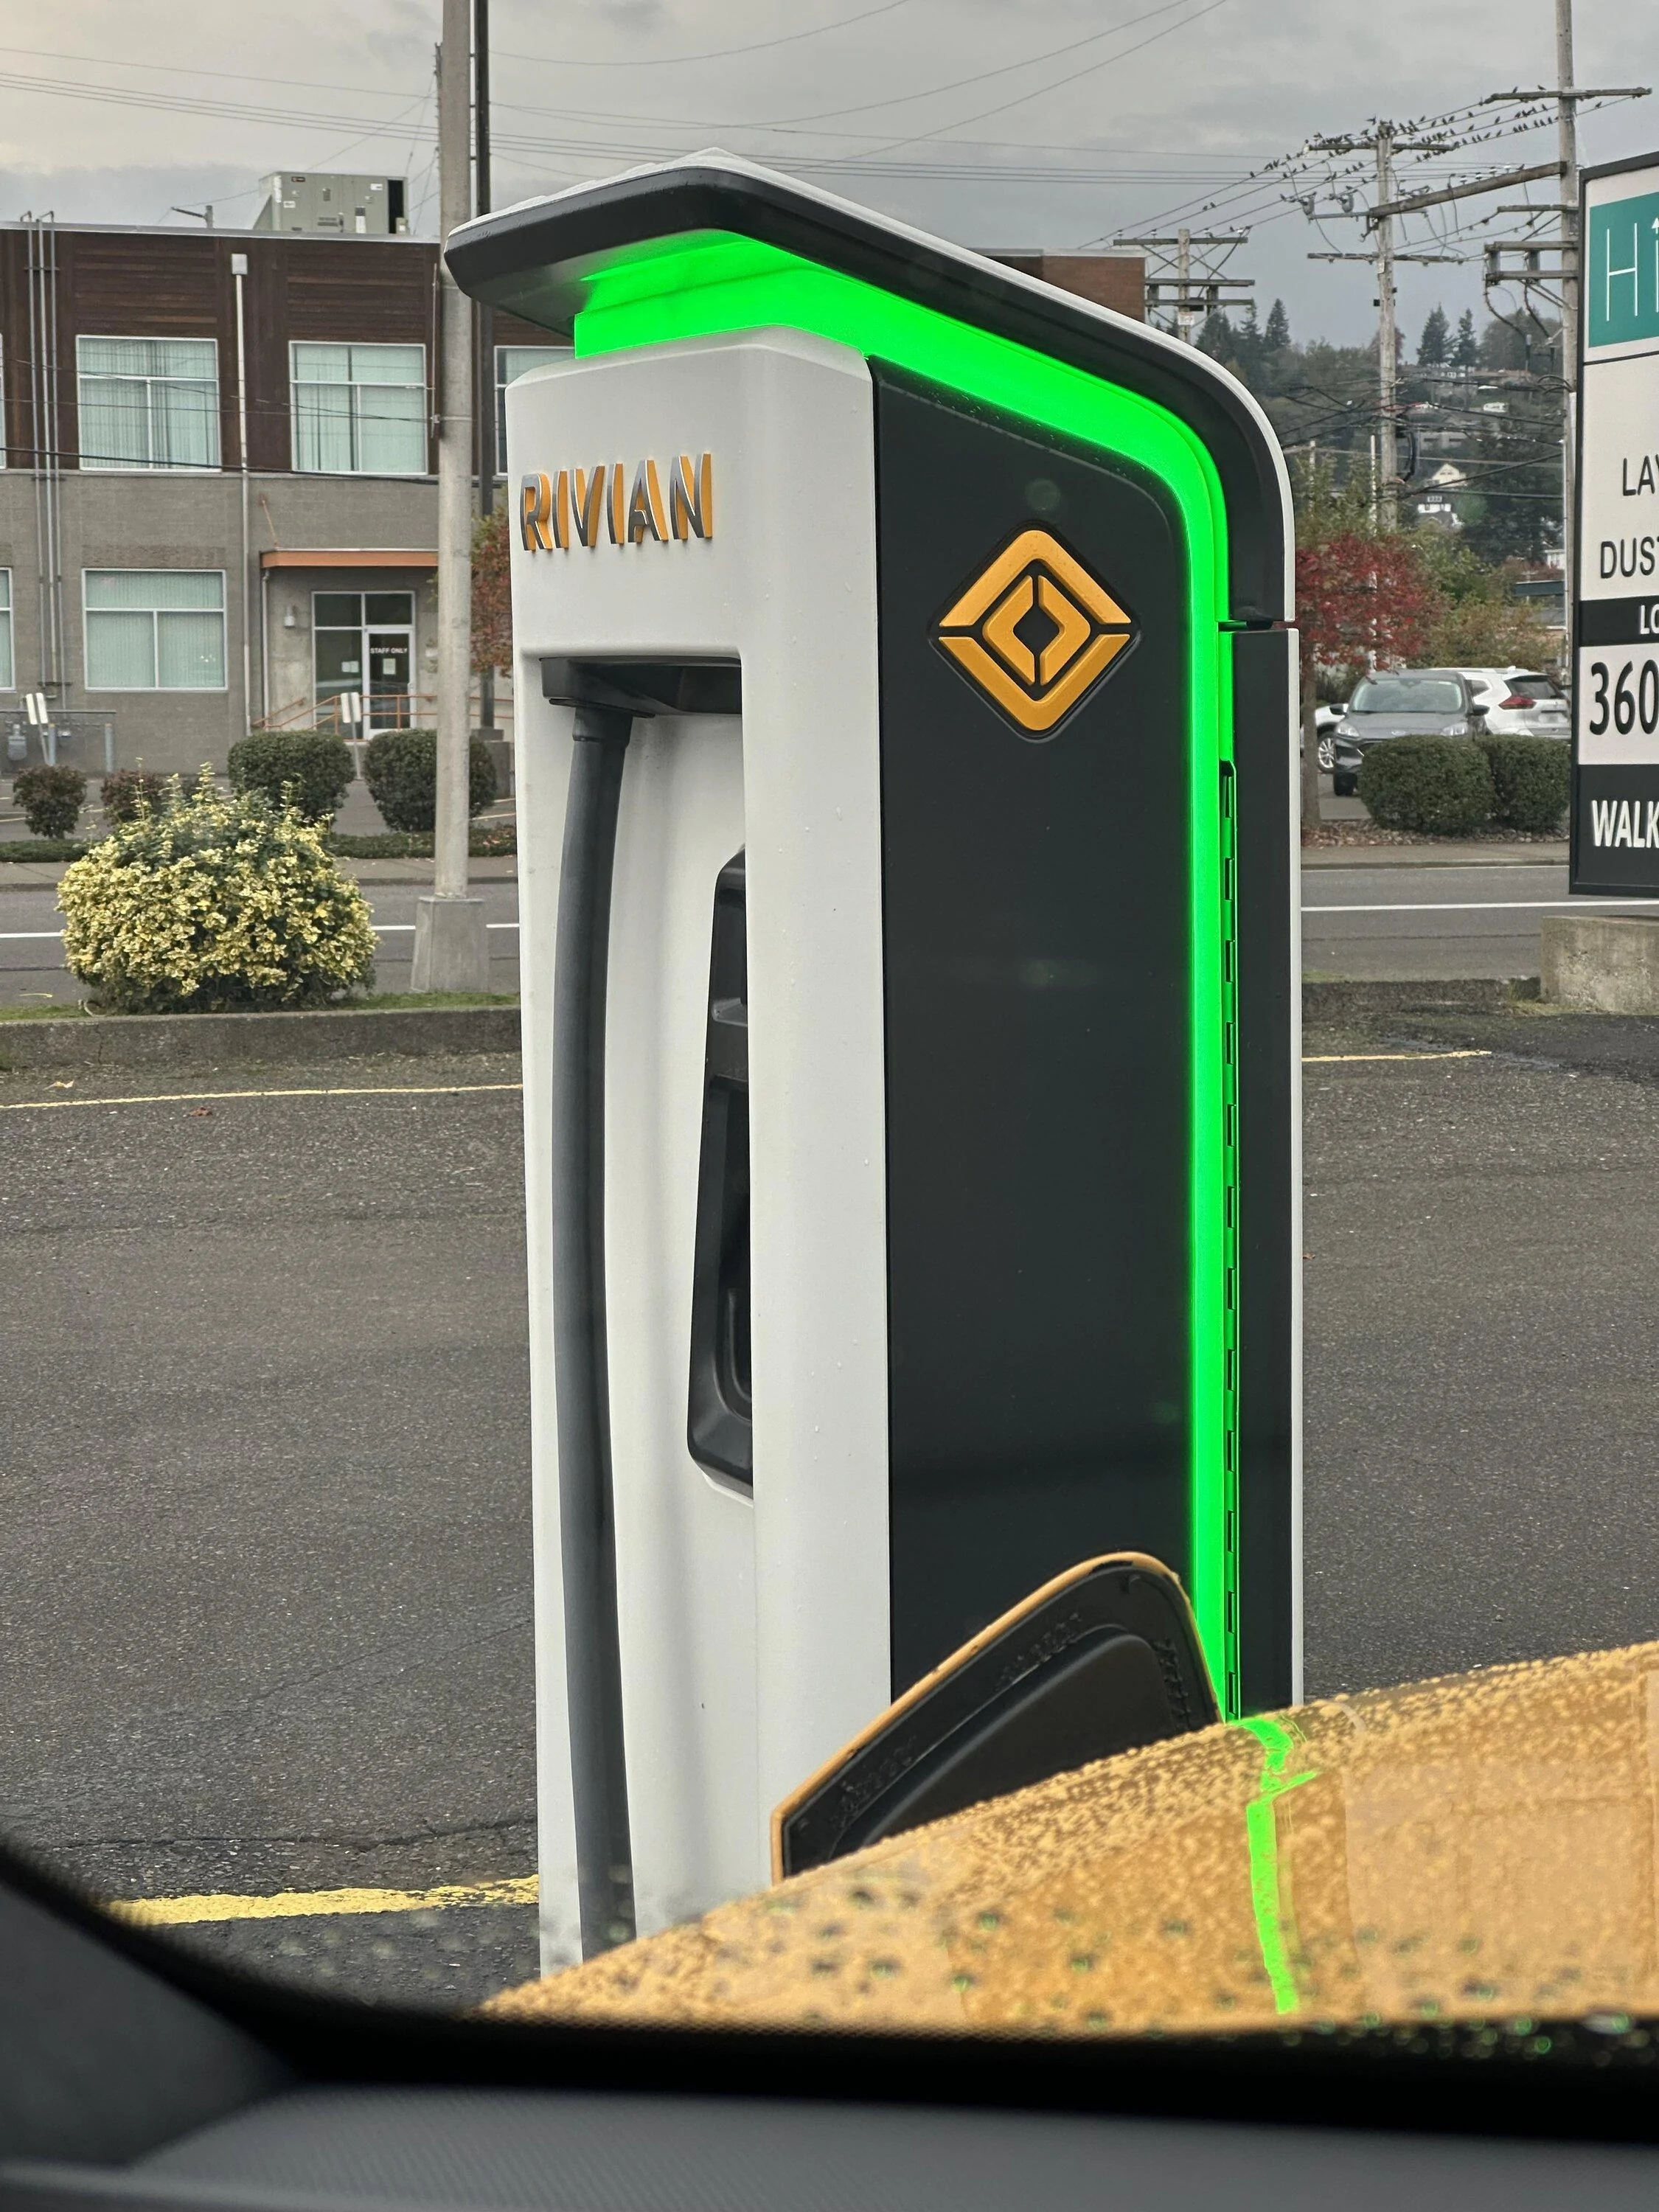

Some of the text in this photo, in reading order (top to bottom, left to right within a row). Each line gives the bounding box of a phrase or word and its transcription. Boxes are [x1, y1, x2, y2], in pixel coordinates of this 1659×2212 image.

[520, 453, 712, 551] RIVIAN
[1601, 536, 1659, 579] DUS
[1590, 659, 1659, 735] 360
[1592, 800, 1659, 849] WALK
